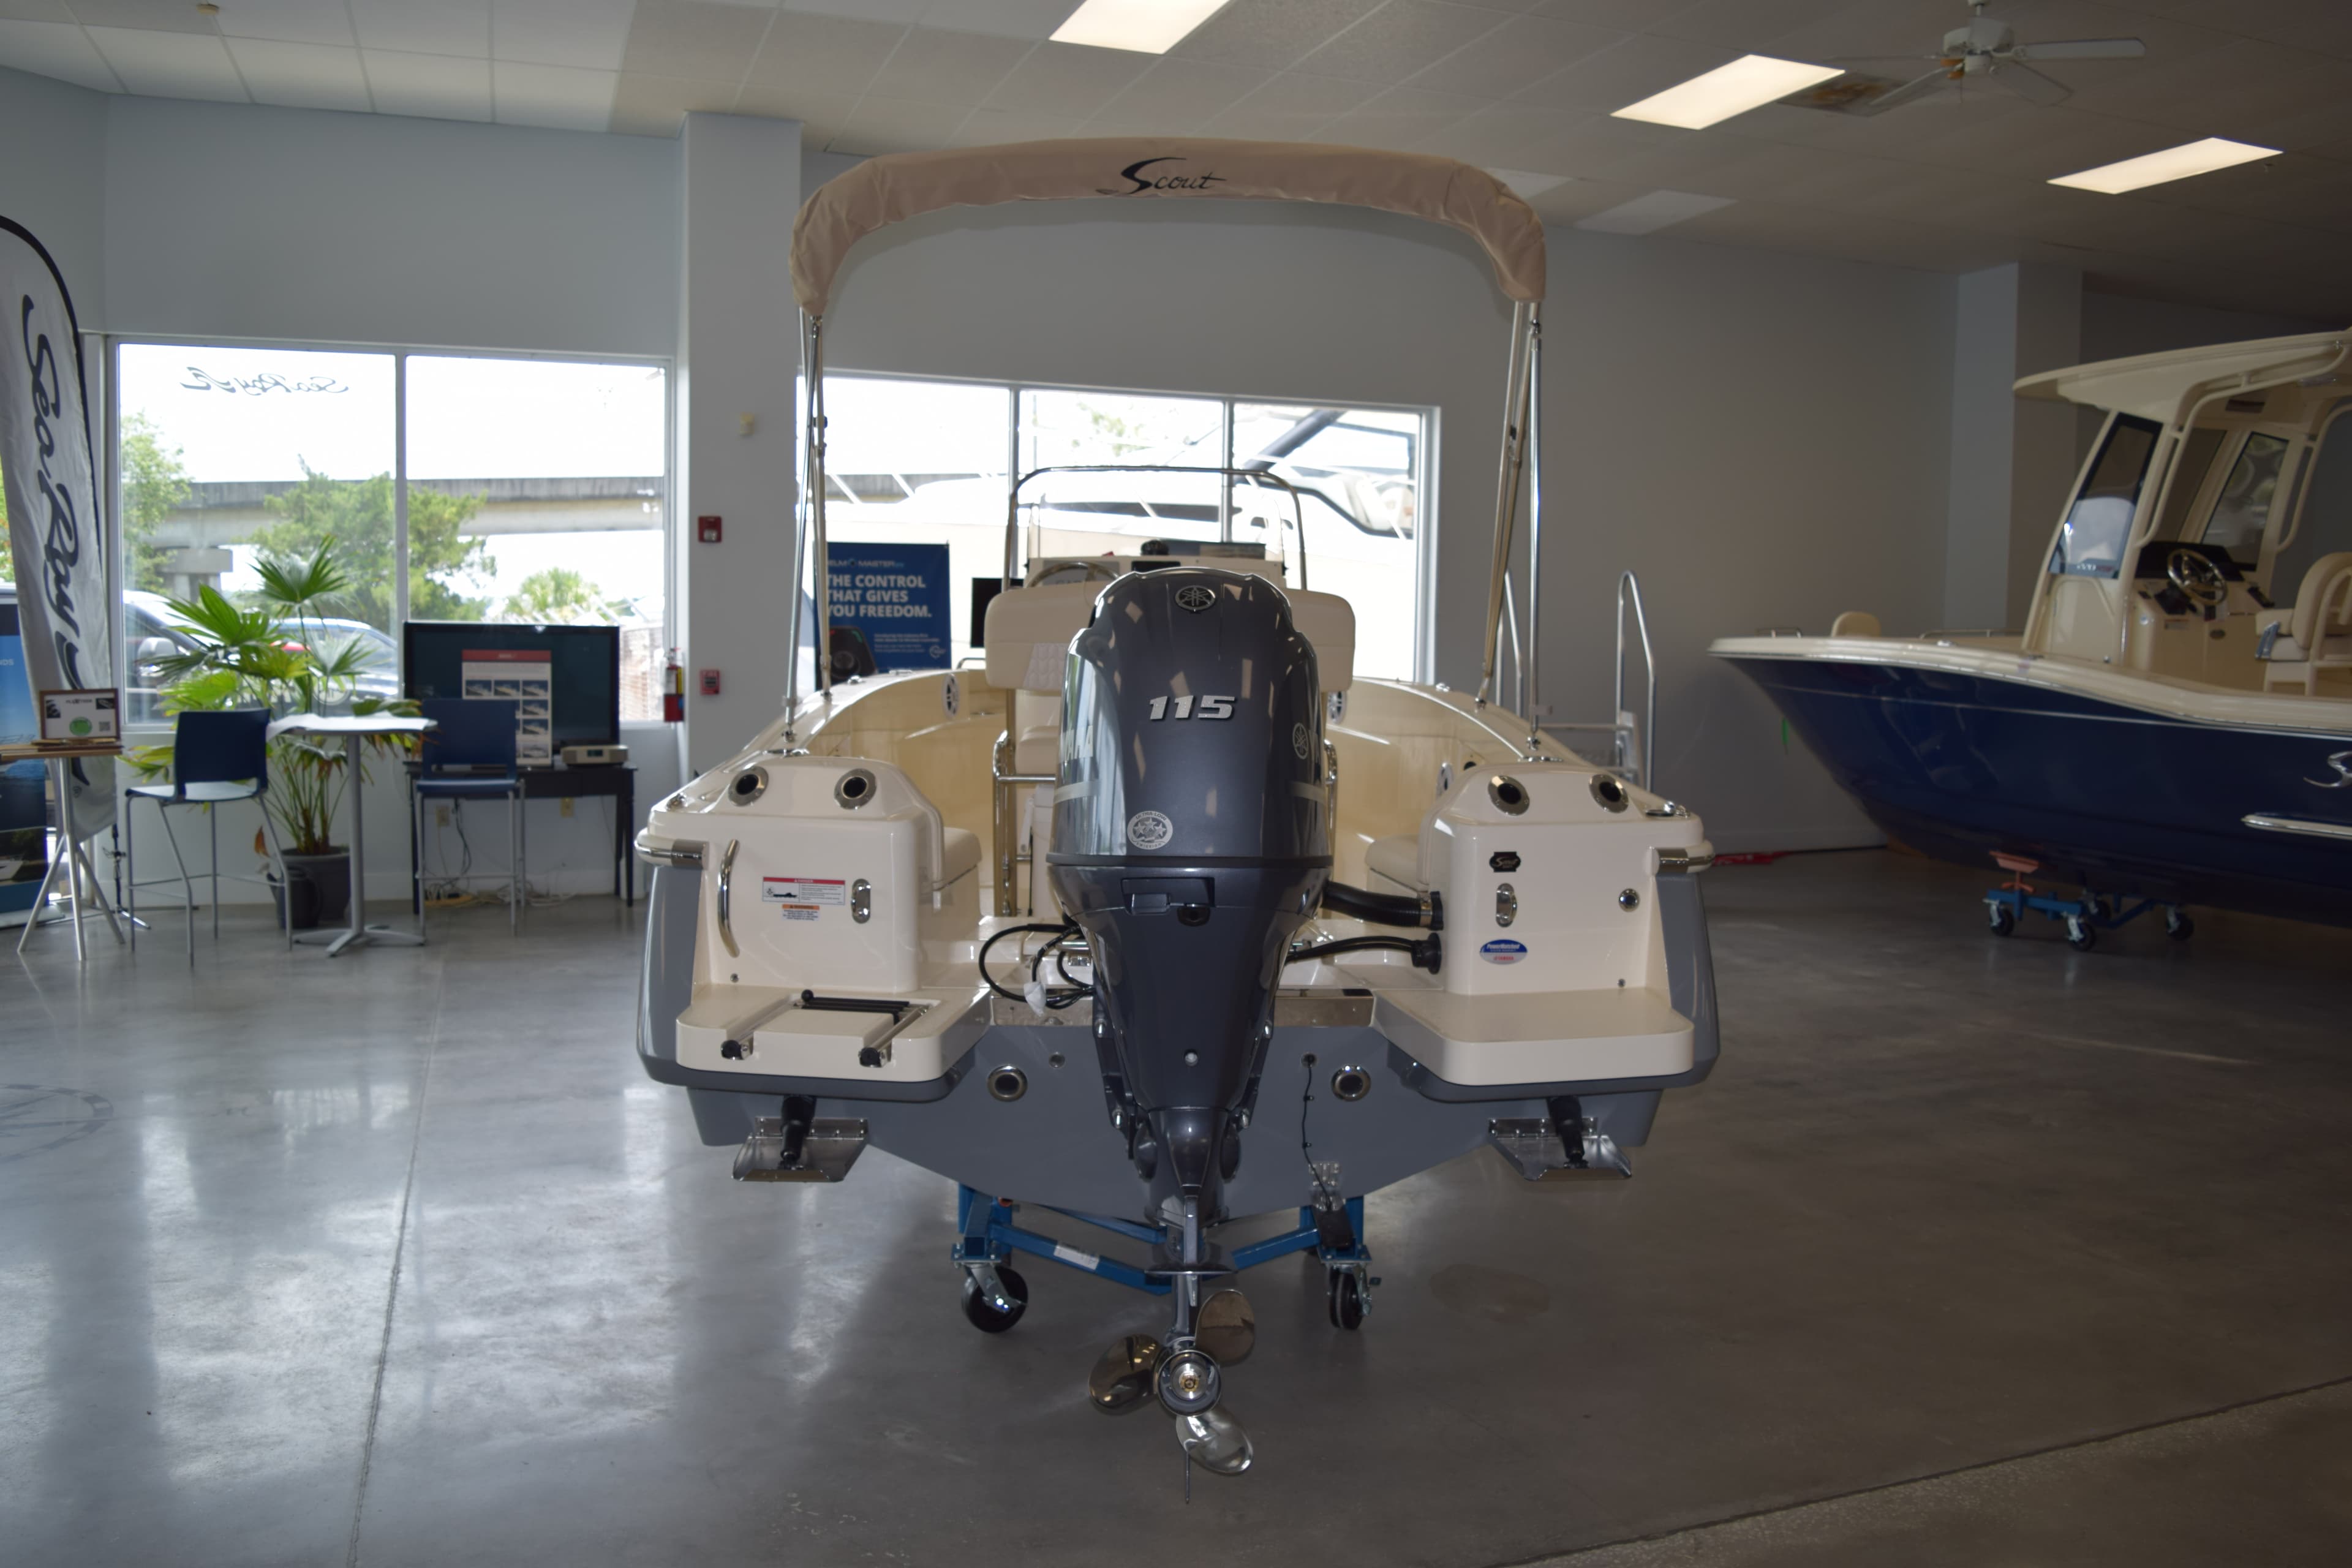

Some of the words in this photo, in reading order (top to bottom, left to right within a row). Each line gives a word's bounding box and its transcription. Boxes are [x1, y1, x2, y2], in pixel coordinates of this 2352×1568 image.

[1095, 157, 1227, 195] Scout
[854, 575, 926, 588] CONTROL
[865, 590, 908, 603] GIVES
[859, 605, 932, 618] FREEDOM.
[1149, 695, 1235, 720] 115
